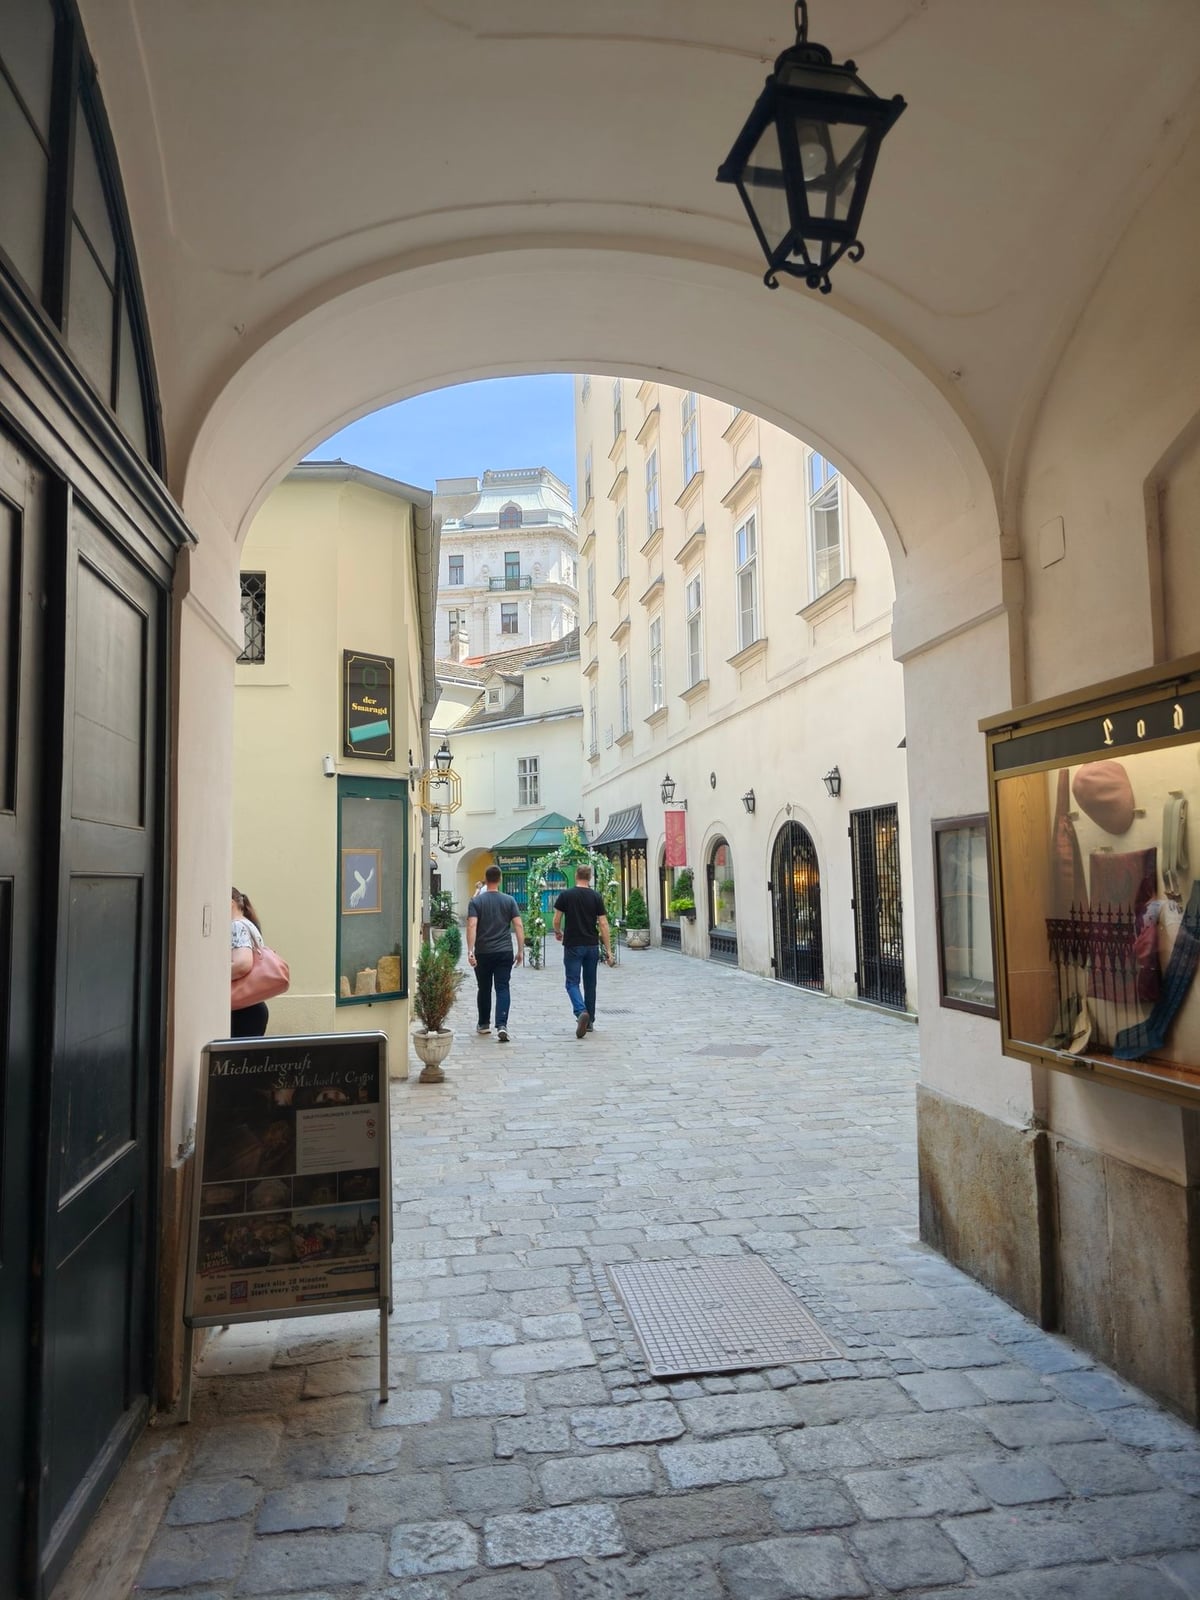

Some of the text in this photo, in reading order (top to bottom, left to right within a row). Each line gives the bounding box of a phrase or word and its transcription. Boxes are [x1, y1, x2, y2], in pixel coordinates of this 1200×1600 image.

[363, 696, 377, 705] der
[351, 702, 388, 715] Smaragd
[211, 1054, 312, 1077] Michaelergruft
[292, 1071, 341, 1088] Michael's
